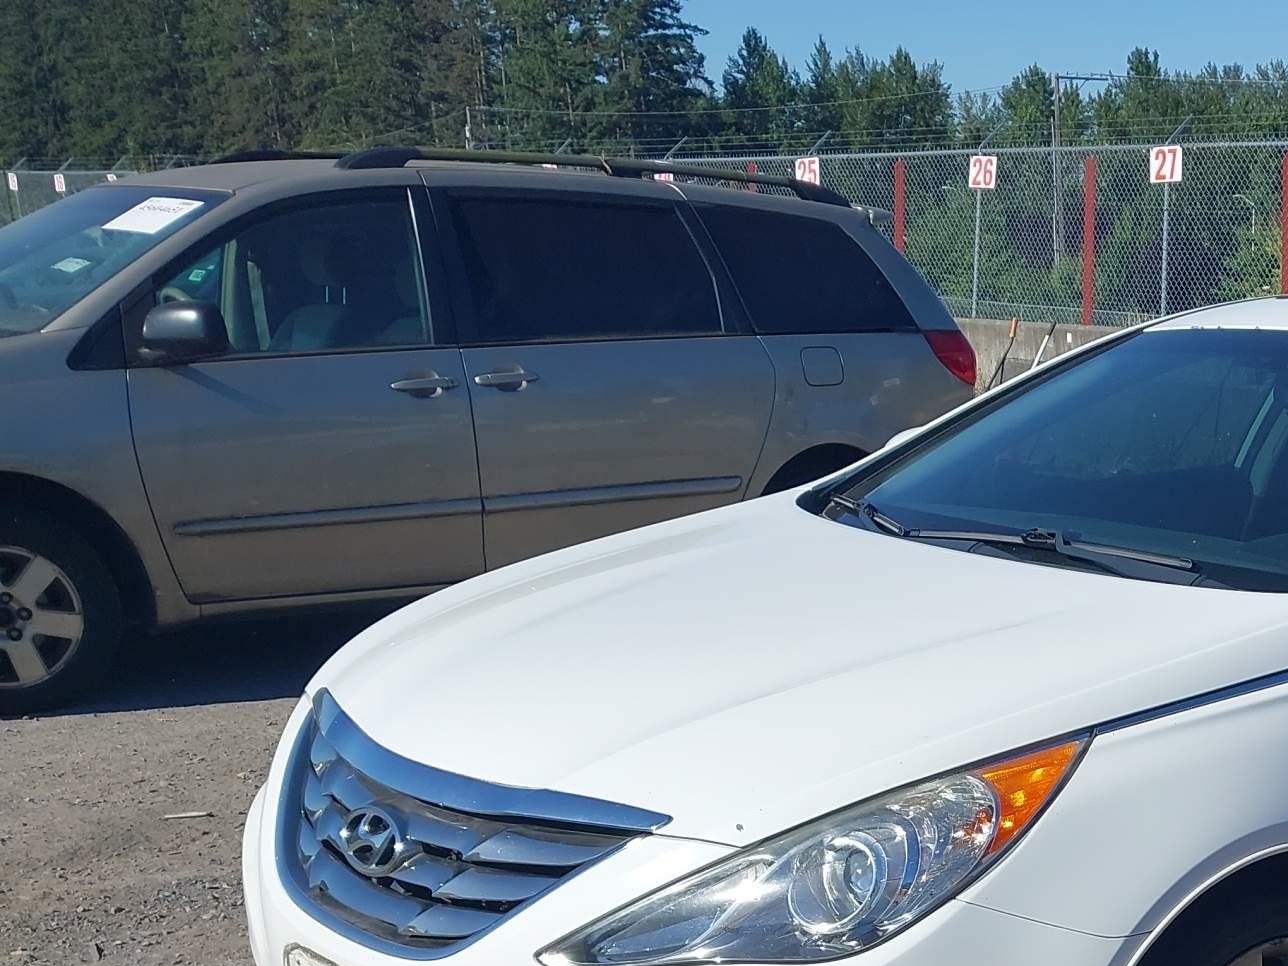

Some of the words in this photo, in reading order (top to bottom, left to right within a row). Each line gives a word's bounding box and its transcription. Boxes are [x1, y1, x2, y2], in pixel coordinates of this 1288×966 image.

[798, 160, 817, 184] 25
[972, 158, 994, 186] 26
[1154, 148, 1178, 181] 27
